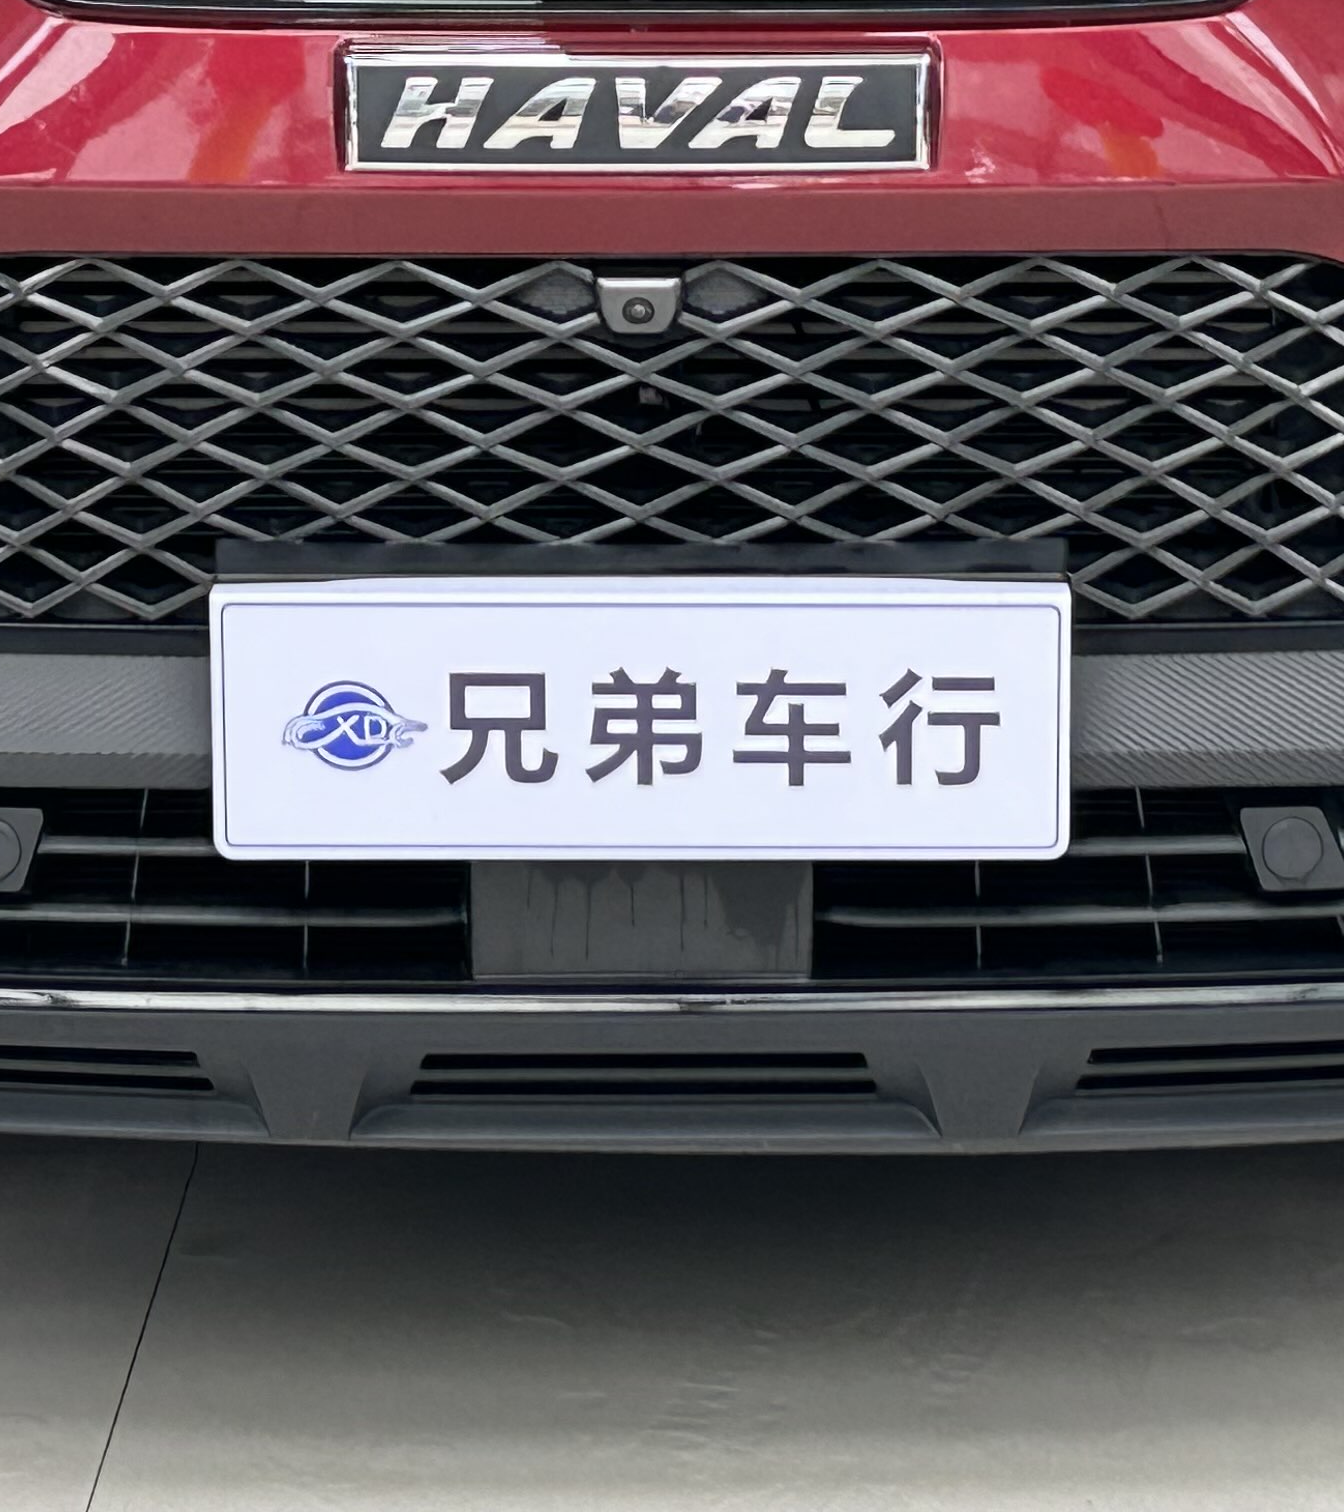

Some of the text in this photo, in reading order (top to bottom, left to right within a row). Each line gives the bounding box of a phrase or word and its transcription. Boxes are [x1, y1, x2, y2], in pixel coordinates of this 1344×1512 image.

[378, 75, 898, 150] HAVAL
[439, 667, 1003, 789] 兄弟车行
